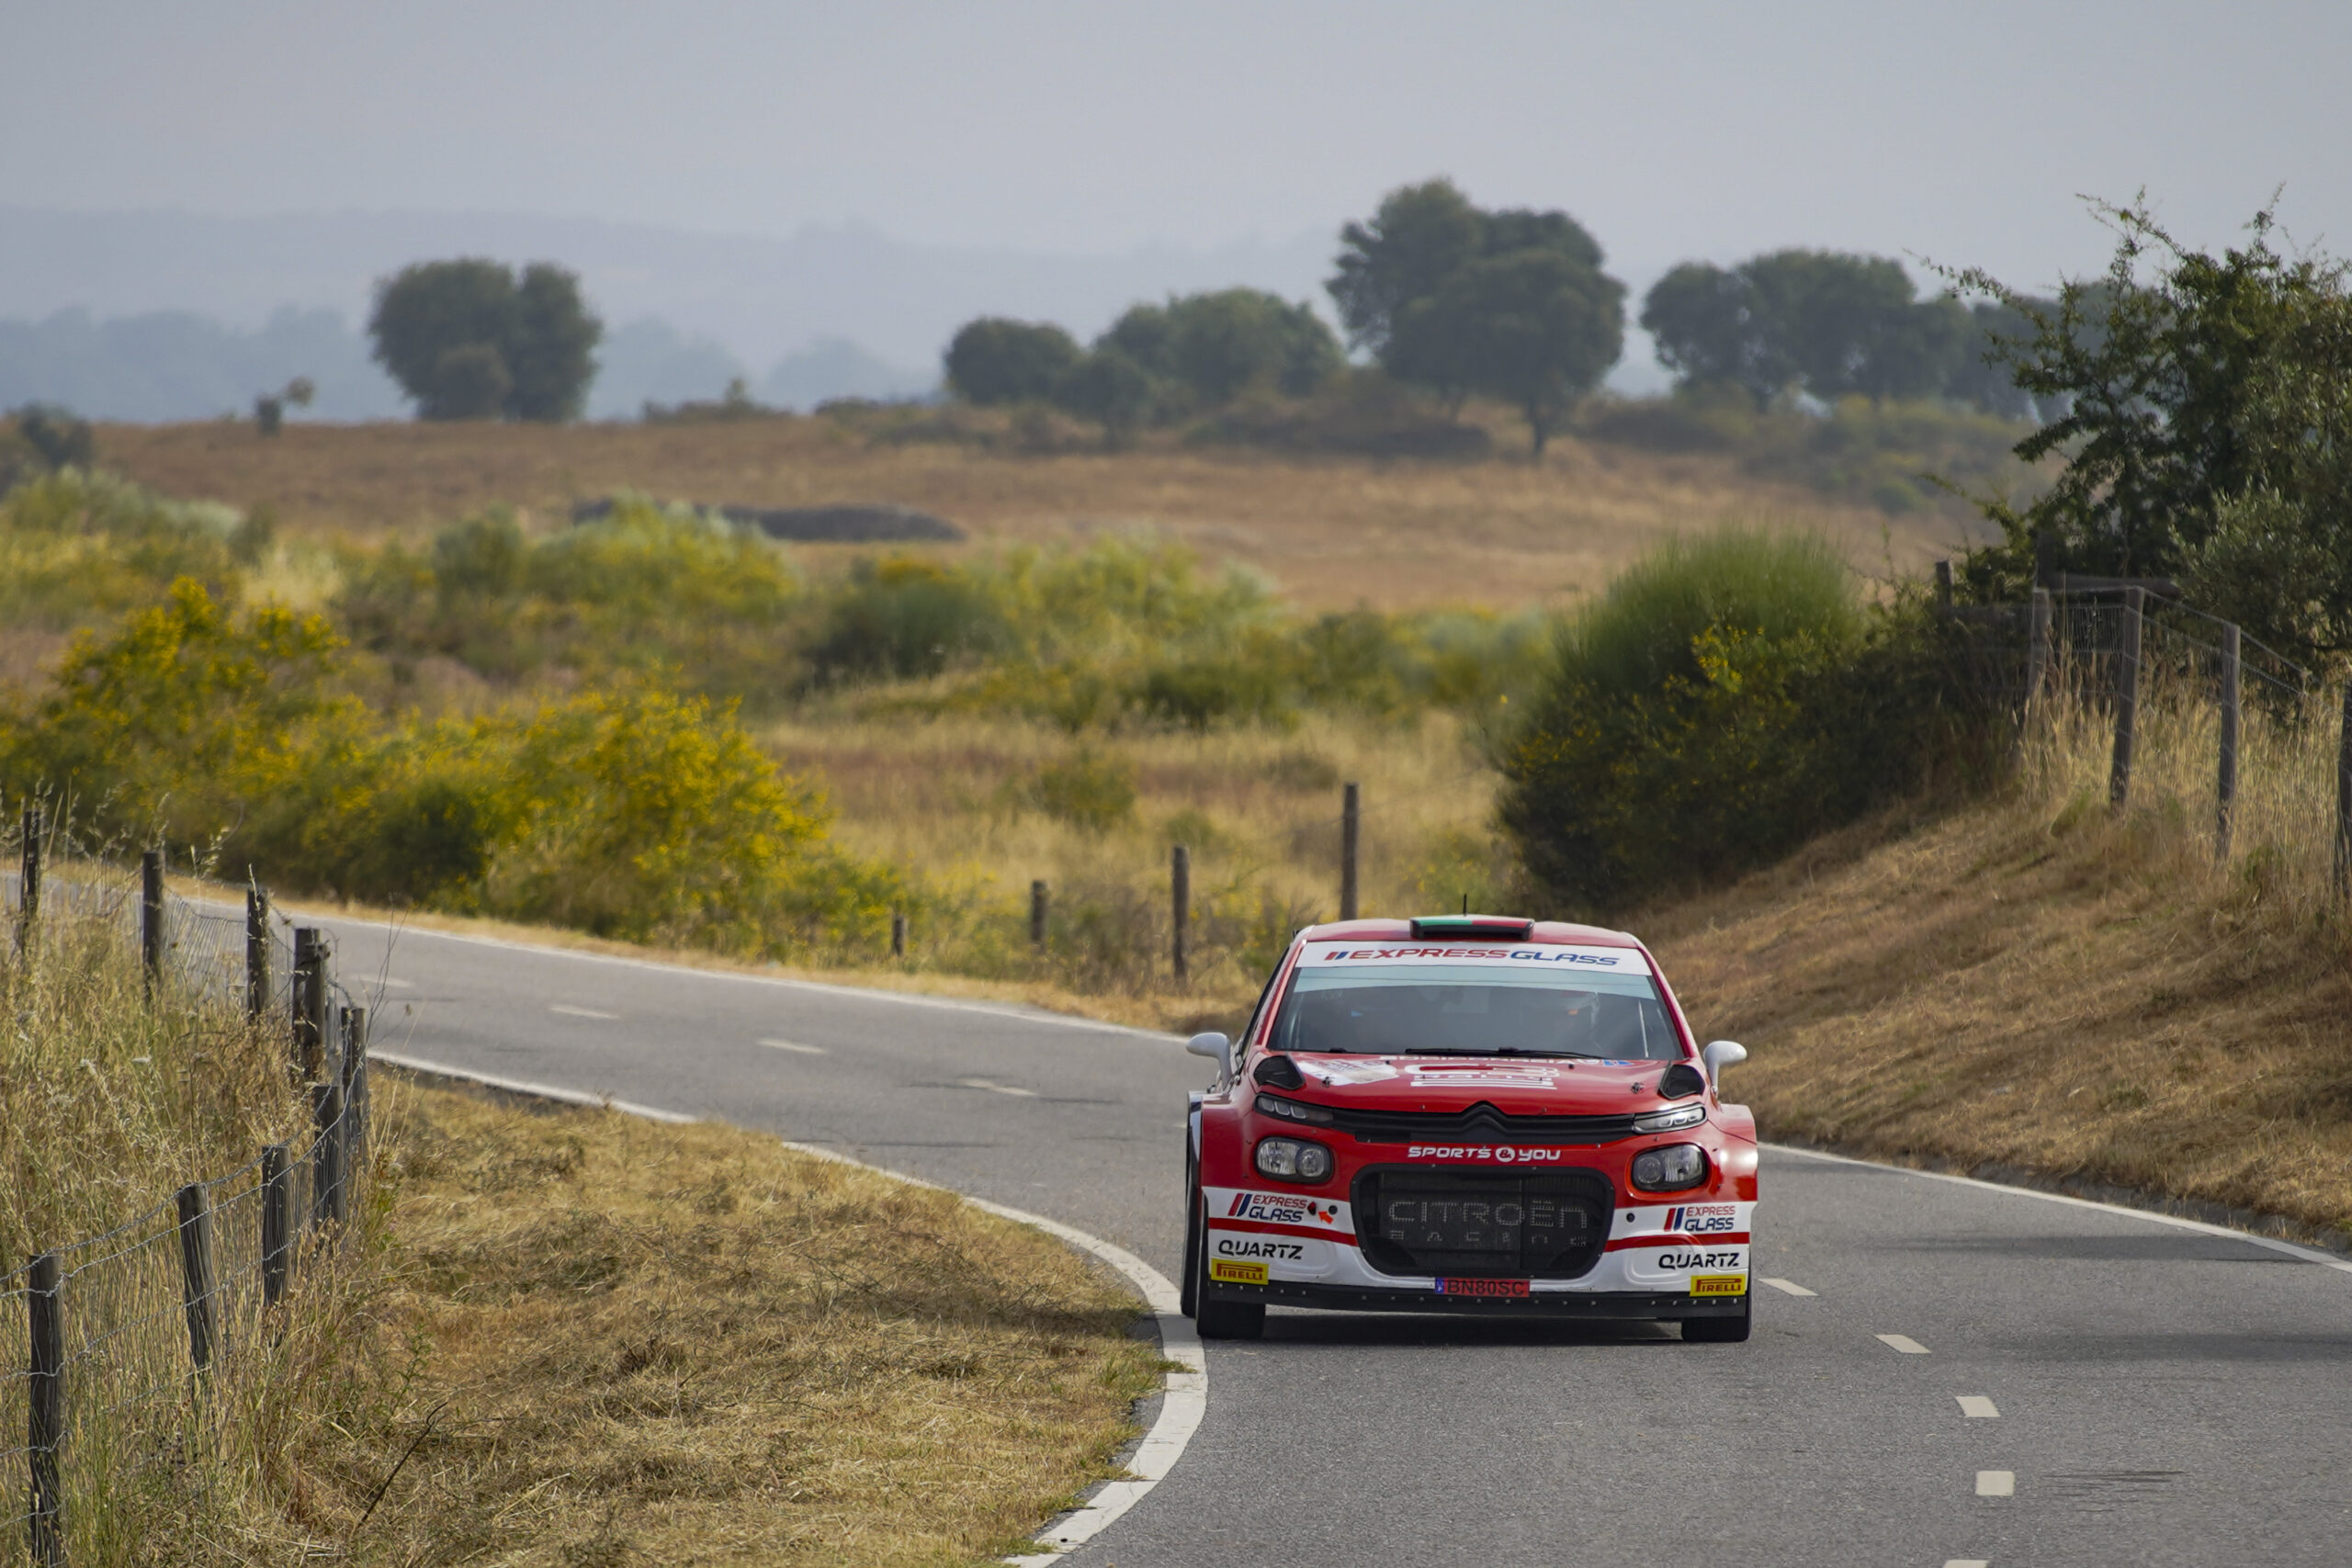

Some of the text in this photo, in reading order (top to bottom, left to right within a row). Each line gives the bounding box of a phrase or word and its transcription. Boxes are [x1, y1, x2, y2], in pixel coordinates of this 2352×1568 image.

[1408, 1146, 1491, 1159] SPORTS
[1518, 1149, 1561, 1161] YOU
[1252, 1194, 1308, 1209] EXPRESS
[1249, 1206, 1304, 1223] GLASS
[1685, 1205, 1736, 1217] EXPRESS
[1684, 1217, 1735, 1232] GLASS
[1218, 1240, 1304, 1260] QUARTZ
[1658, 1252, 1740, 1270] QUARTZ
[1216, 1263, 1263, 1280] PIRELLI
[1696, 1278, 1742, 1292] PIRELLI
